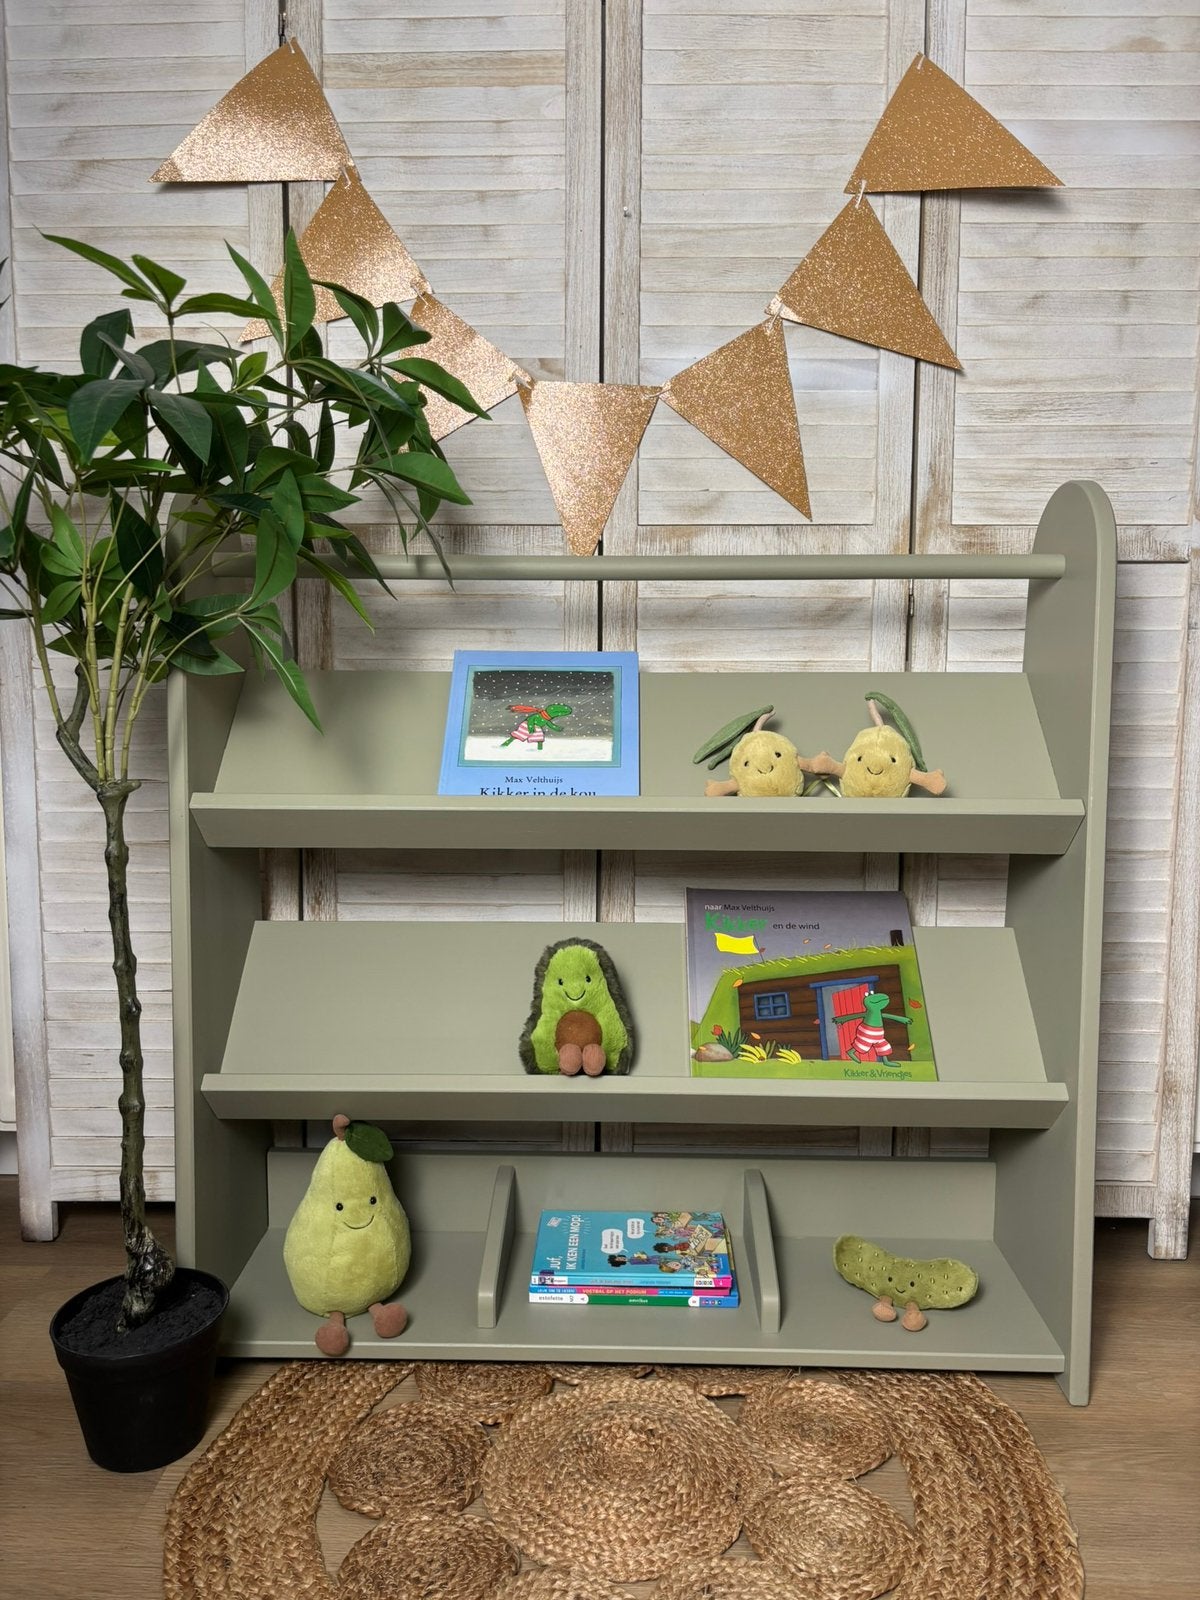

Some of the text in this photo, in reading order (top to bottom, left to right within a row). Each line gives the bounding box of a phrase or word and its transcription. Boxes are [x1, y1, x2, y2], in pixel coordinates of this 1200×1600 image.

[526, 776, 564, 785] Velthuijs
[741, 904, 775, 912] Velthuijs
[704, 911, 768, 931] Kikker
[785, 922, 797, 930] de
[798, 922, 820, 930] wind
[568, 1233, 579, 1246] EEN
[567, 1247, 578, 1262] KEN
[565, 1262, 577, 1270] IK
